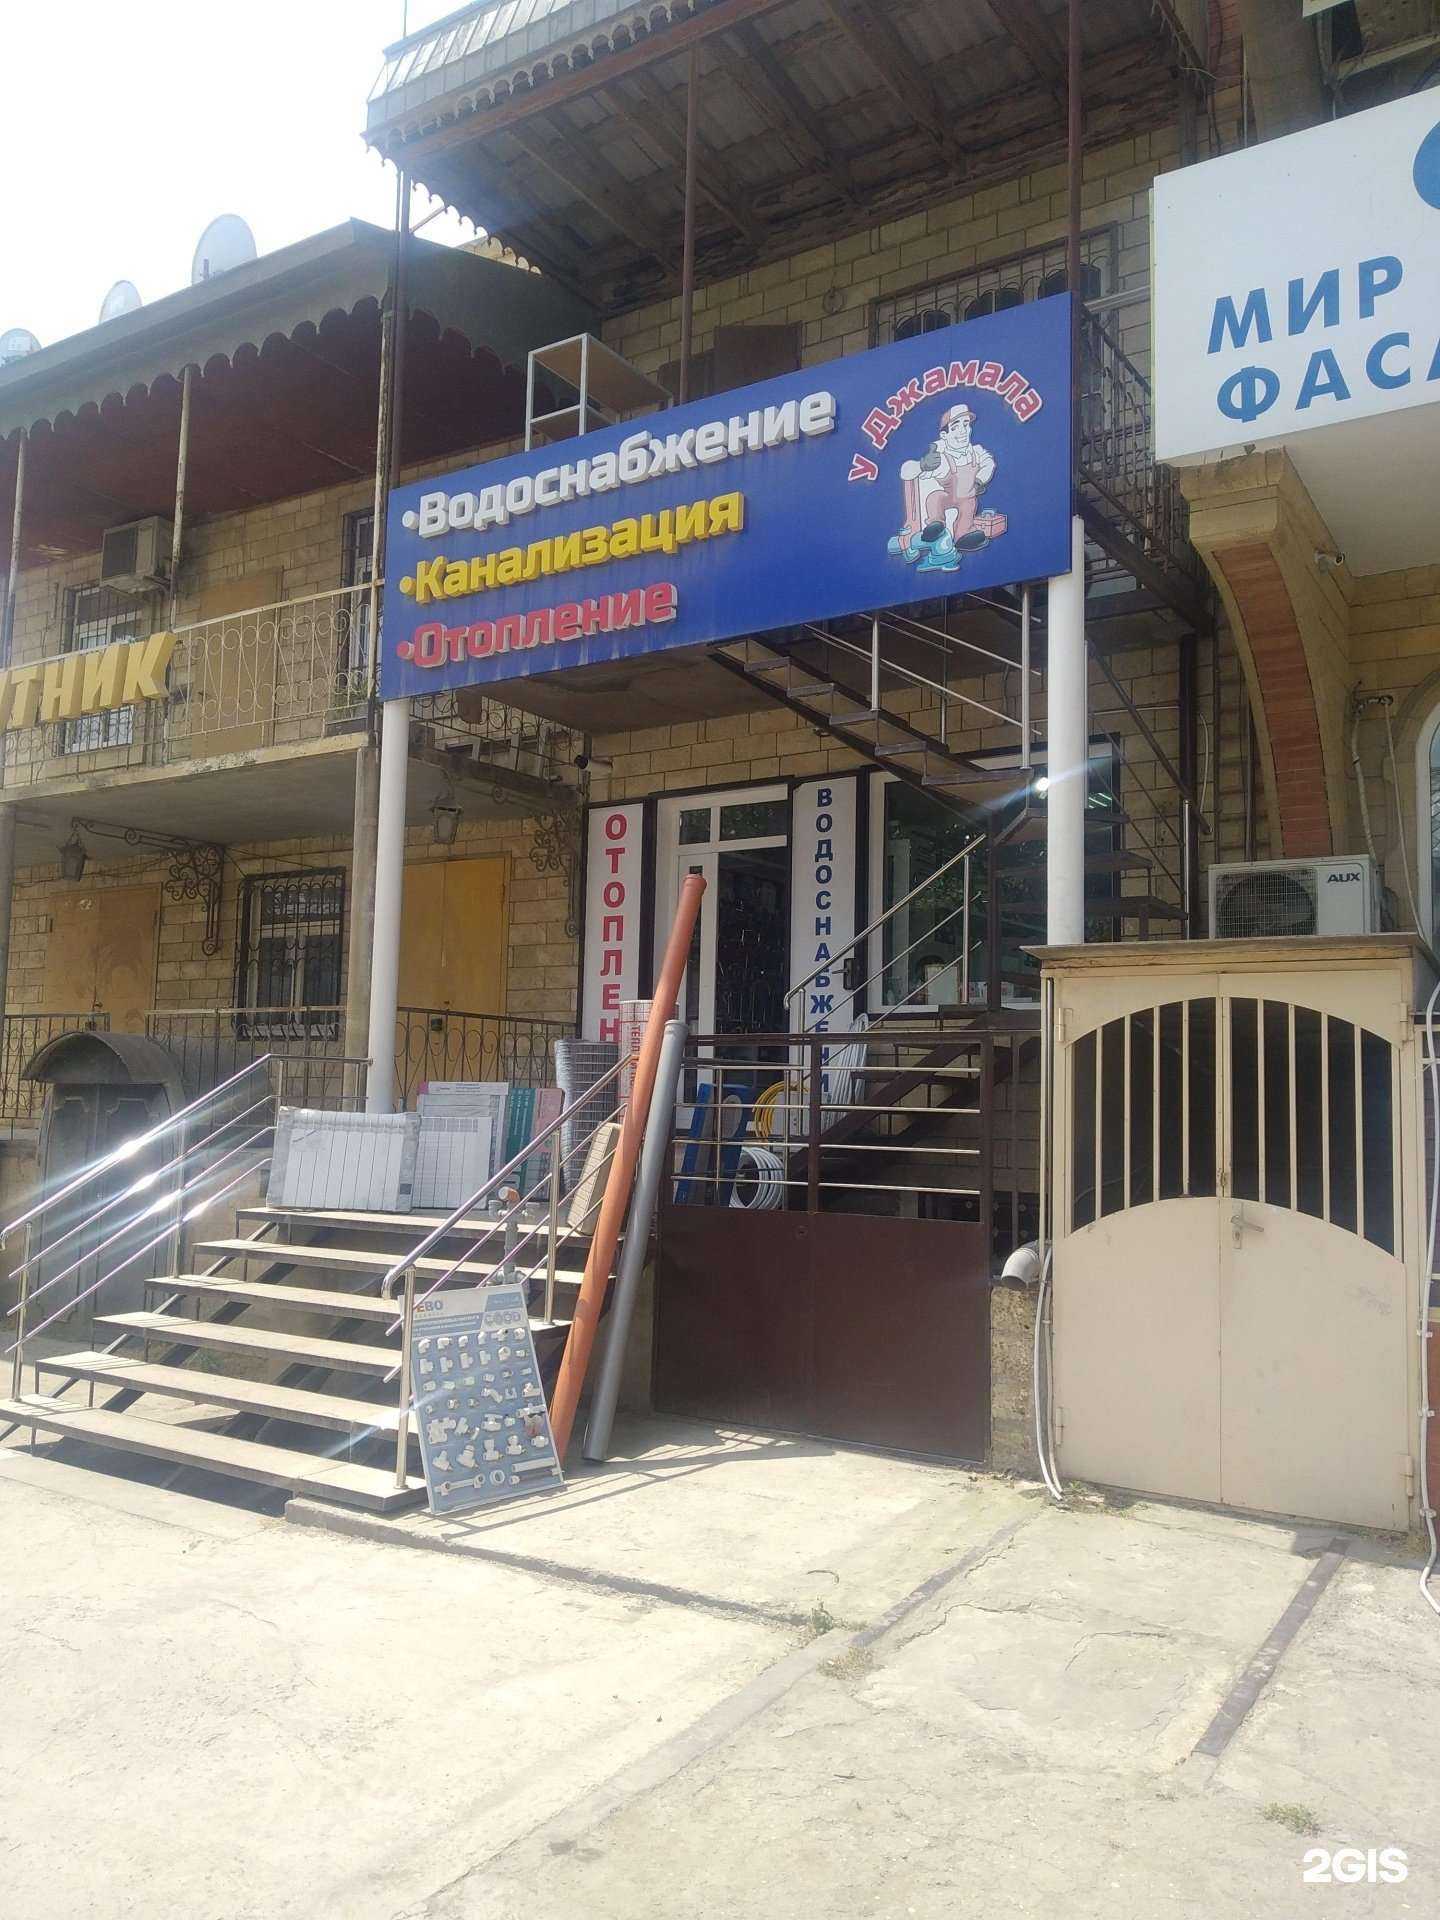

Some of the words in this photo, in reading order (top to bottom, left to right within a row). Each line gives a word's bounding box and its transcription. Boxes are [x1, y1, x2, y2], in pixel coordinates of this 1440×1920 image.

[1207, 255, 1403, 354] МИР
[861, 360, 1043, 450] Джамала
[1217, 332, 1440, 423] ФАС
[418, 391, 837, 538] Водоснабжение
[416, 491, 745, 603] Канализация
[413, 582, 678, 668] Отопление
[0, 631, 177, 734] ТНИК
[1326, 872, 1361, 883] AUX
